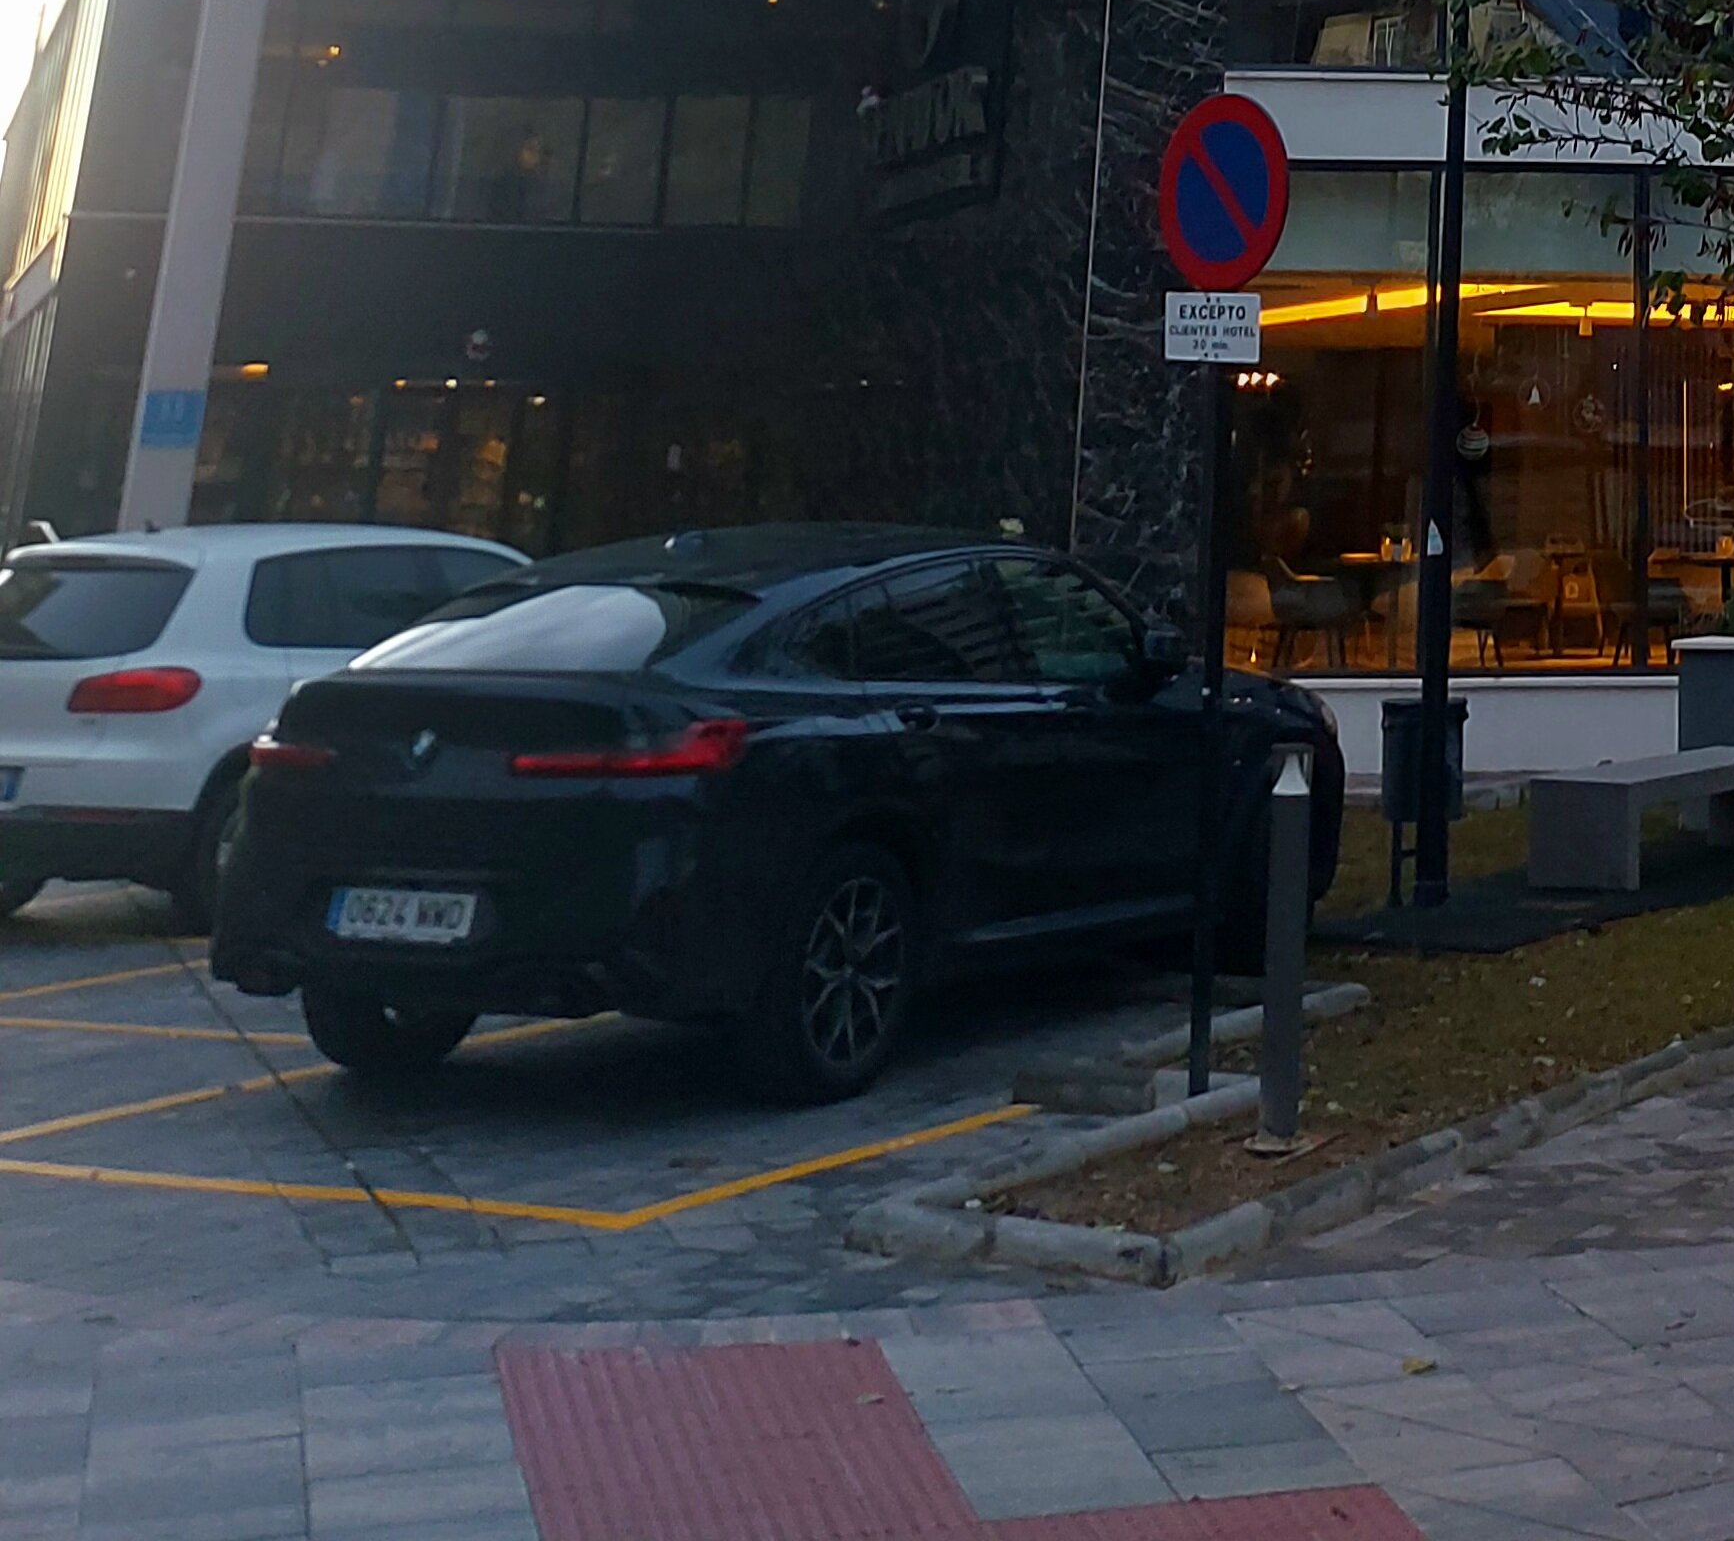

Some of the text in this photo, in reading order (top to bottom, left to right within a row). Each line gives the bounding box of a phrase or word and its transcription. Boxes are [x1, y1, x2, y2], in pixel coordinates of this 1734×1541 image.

[1180, 304, 1246, 321] EXCEPTO
[1169, 325, 1256, 337] CLIENTES HOTEL
